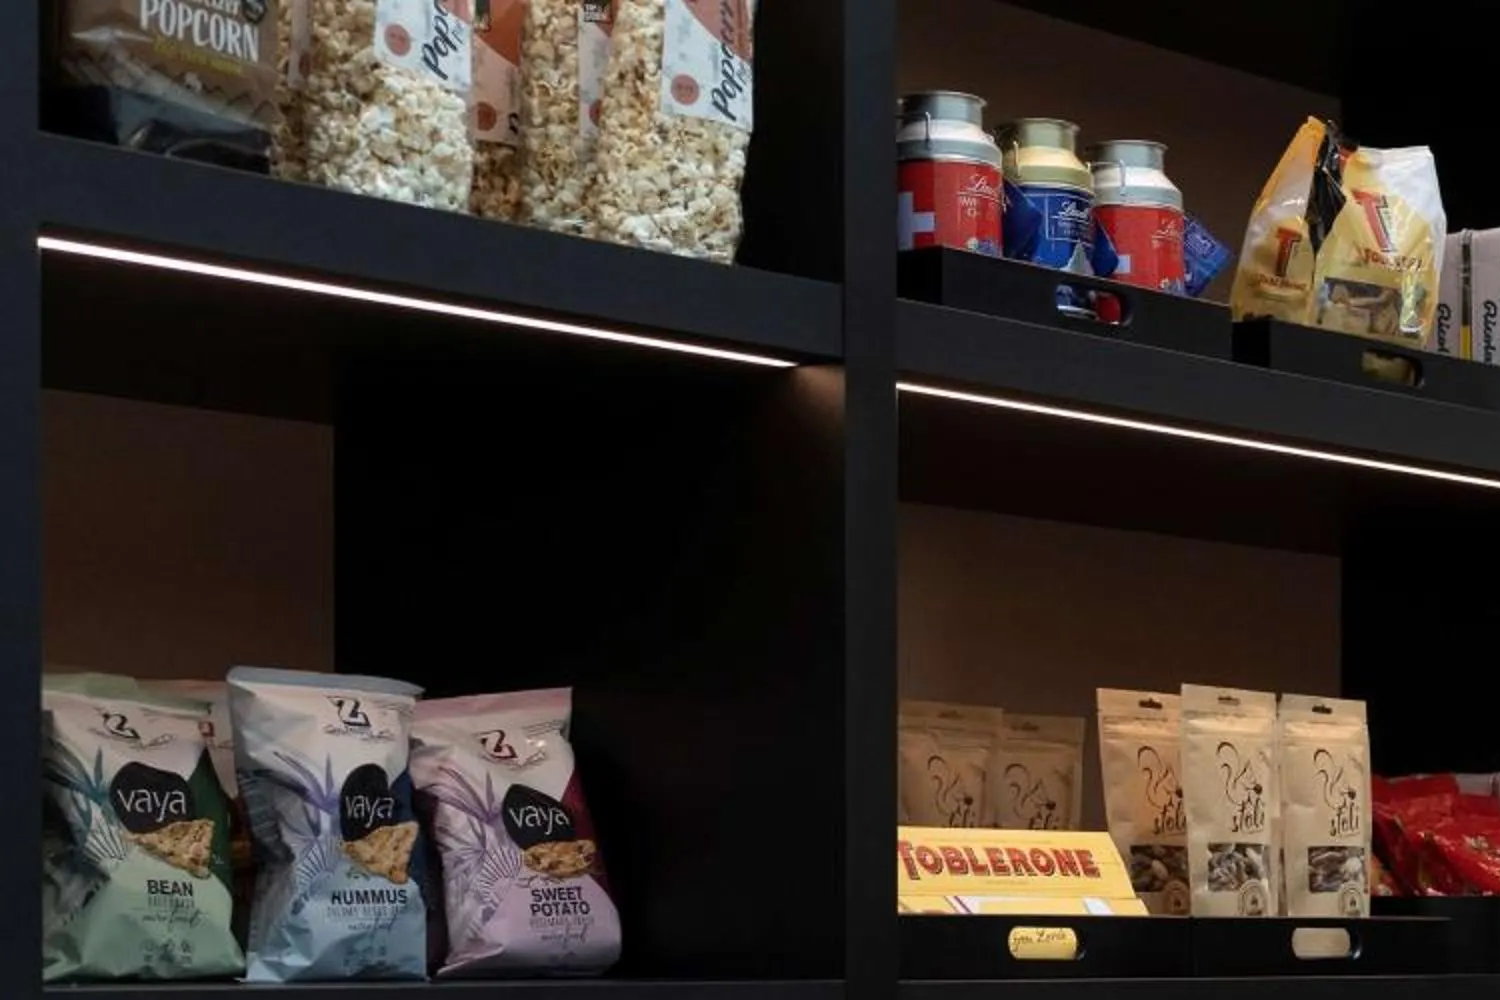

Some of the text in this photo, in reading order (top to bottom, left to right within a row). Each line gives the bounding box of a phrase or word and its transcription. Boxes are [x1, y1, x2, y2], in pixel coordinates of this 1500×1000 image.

[140, 0, 259, 63] POPCORN
[118, 789, 187, 822] vaya
[345, 795, 394, 828] vaya
[508, 805, 570, 835] vaya
[897, 840, 1101, 881] TOBLERONE
[147, 879, 193, 897] BEAN
[331, 889, 407, 905] HUMMUS
[531, 887, 581, 902] SWEET
[530, 901, 590, 917] POTATO
